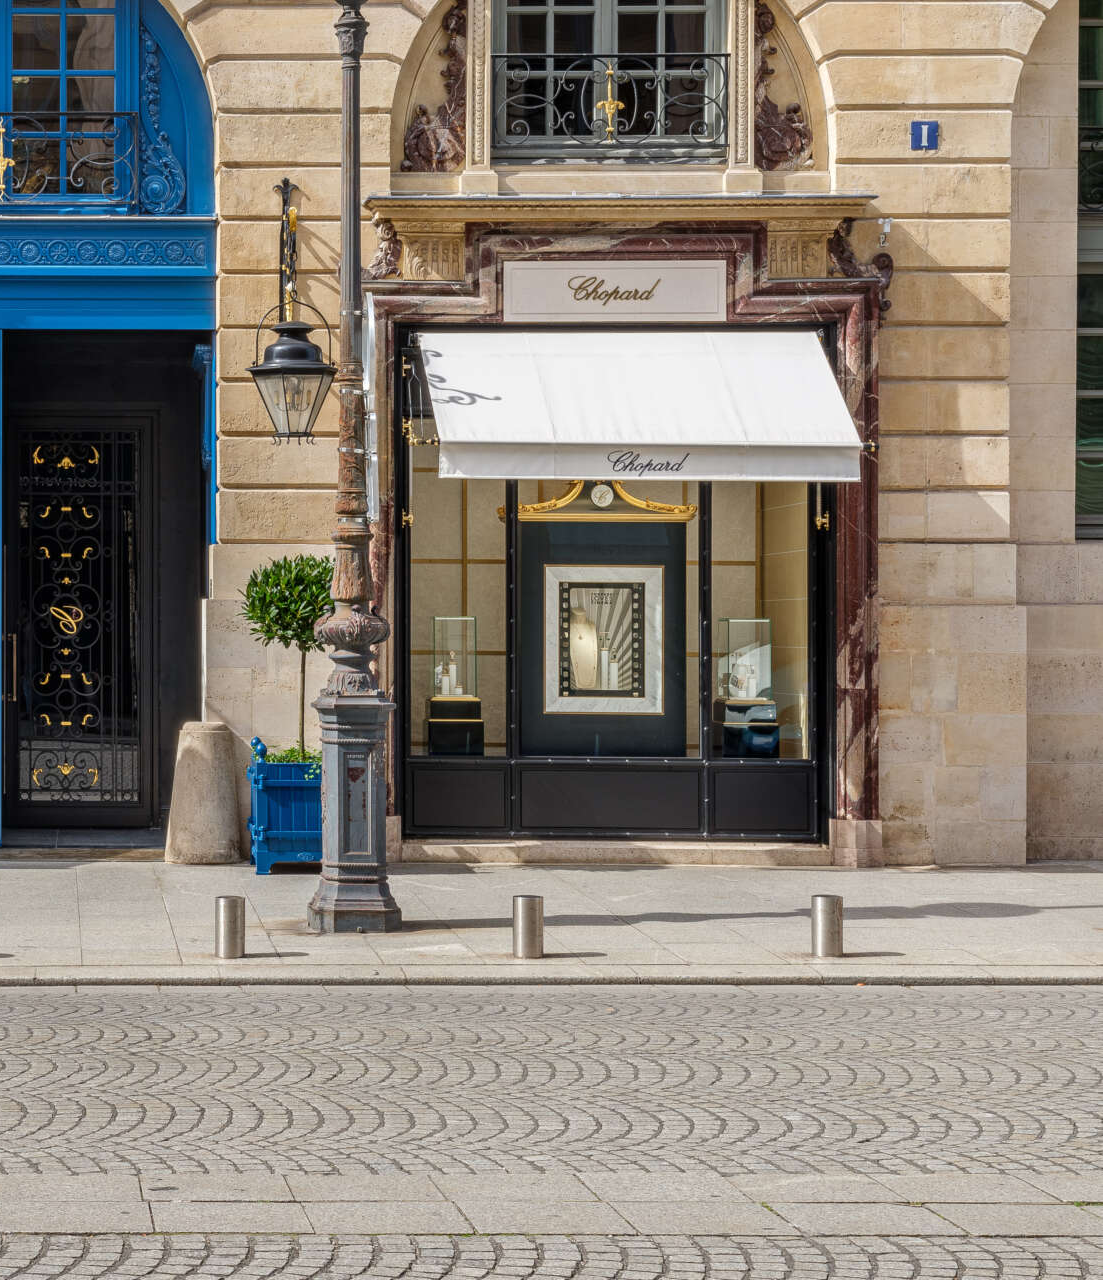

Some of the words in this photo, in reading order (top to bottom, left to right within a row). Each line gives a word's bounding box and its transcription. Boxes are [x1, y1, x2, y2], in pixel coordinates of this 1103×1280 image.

[920, 124, 929, 147] 1
[567, 275, 662, 306] Chopard
[606, 450, 691, 477] Chopard
